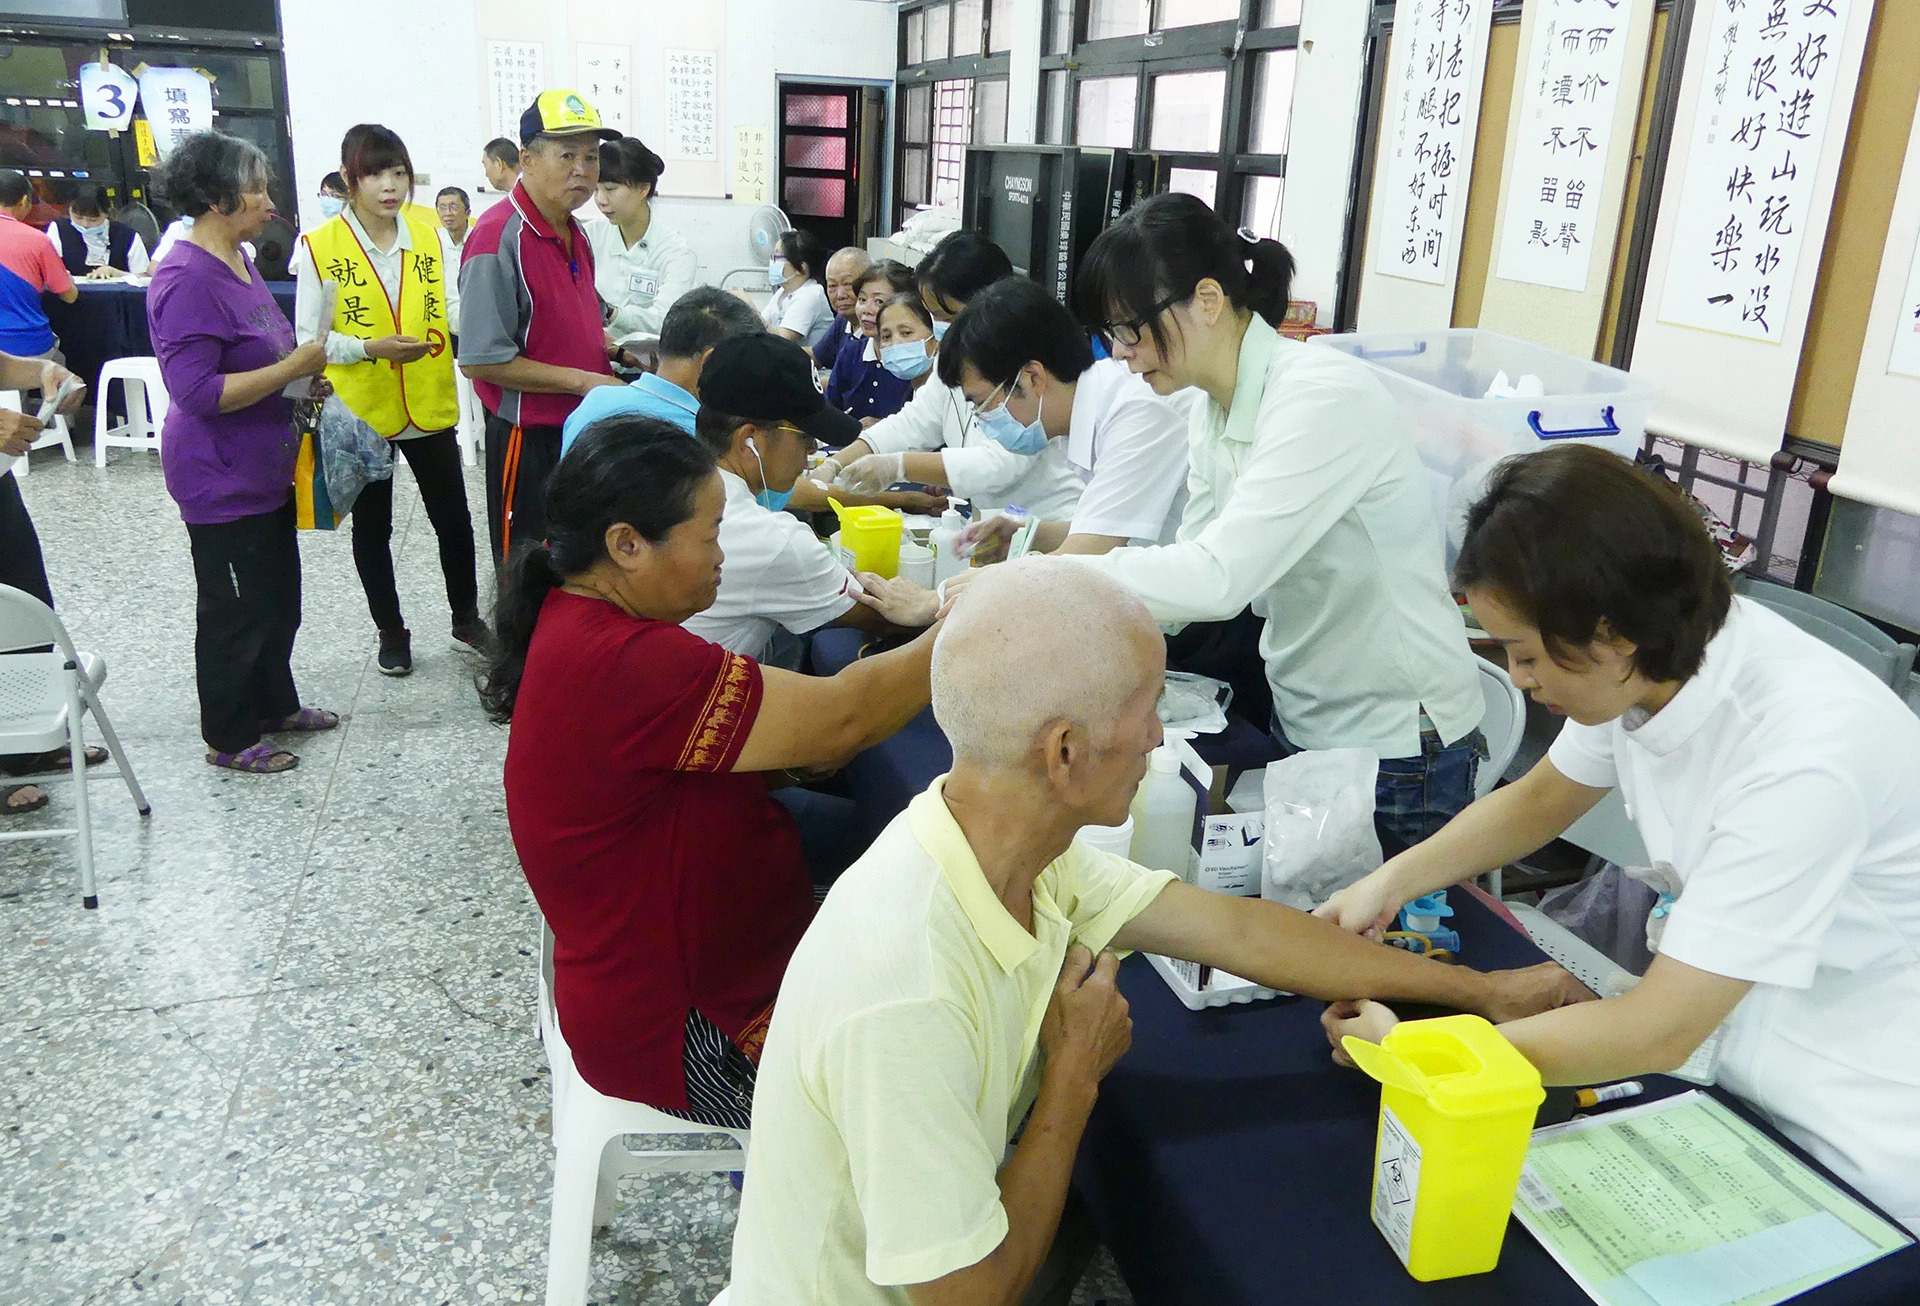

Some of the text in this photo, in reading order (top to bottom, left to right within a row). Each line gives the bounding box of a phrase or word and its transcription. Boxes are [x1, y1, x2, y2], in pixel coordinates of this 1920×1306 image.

[96, 83, 127, 119] 3
[326, 257, 378, 364] 就是
[412, 252, 443, 323] 健康
